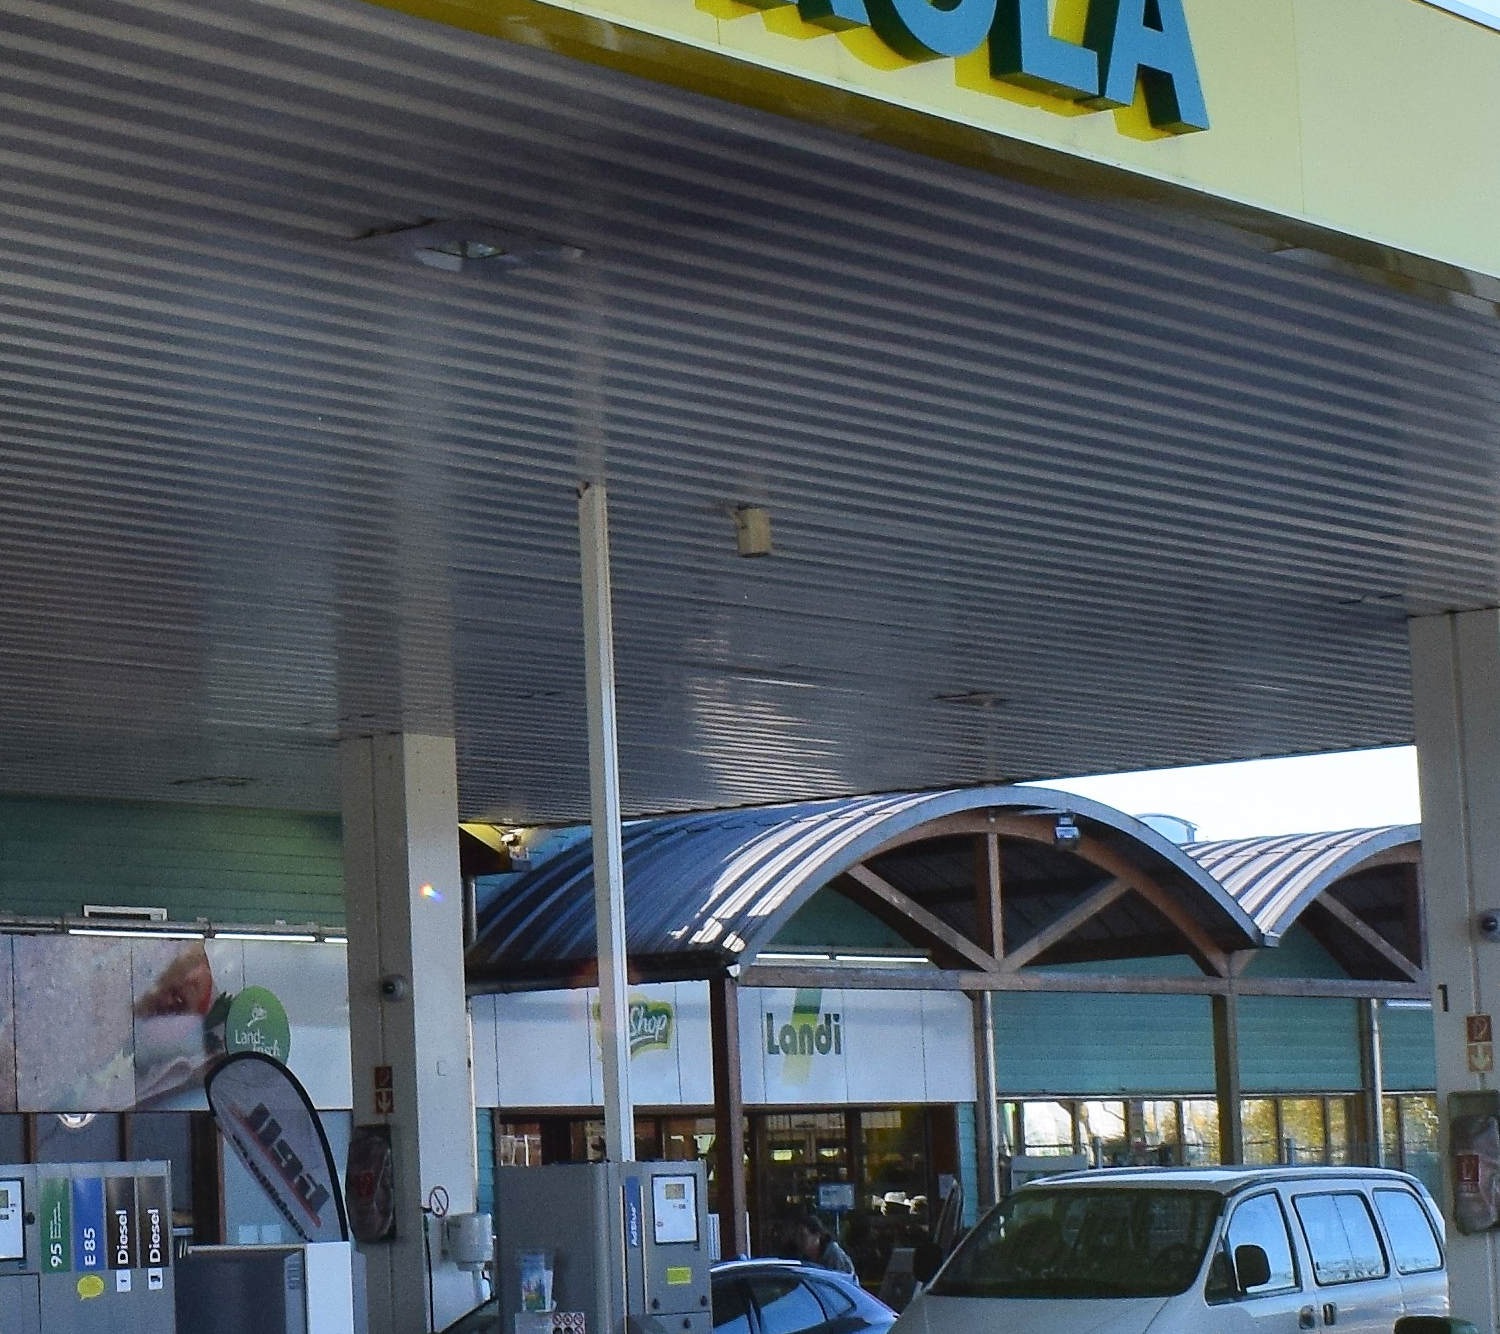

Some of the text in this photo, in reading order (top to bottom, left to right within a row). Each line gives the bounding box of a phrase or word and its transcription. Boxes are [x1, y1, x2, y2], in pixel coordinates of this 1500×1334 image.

[1437, 983, 1449, 1012] 1
[629, 1005, 669, 1041] Shop
[766, 1011, 843, 1056] Landi
[51, 1242, 63, 1267] 95
[84, 1227, 96, 1267] E 85
[115, 1209, 129, 1265] Diesel
[147, 1208, 161, 1264] Diesel
